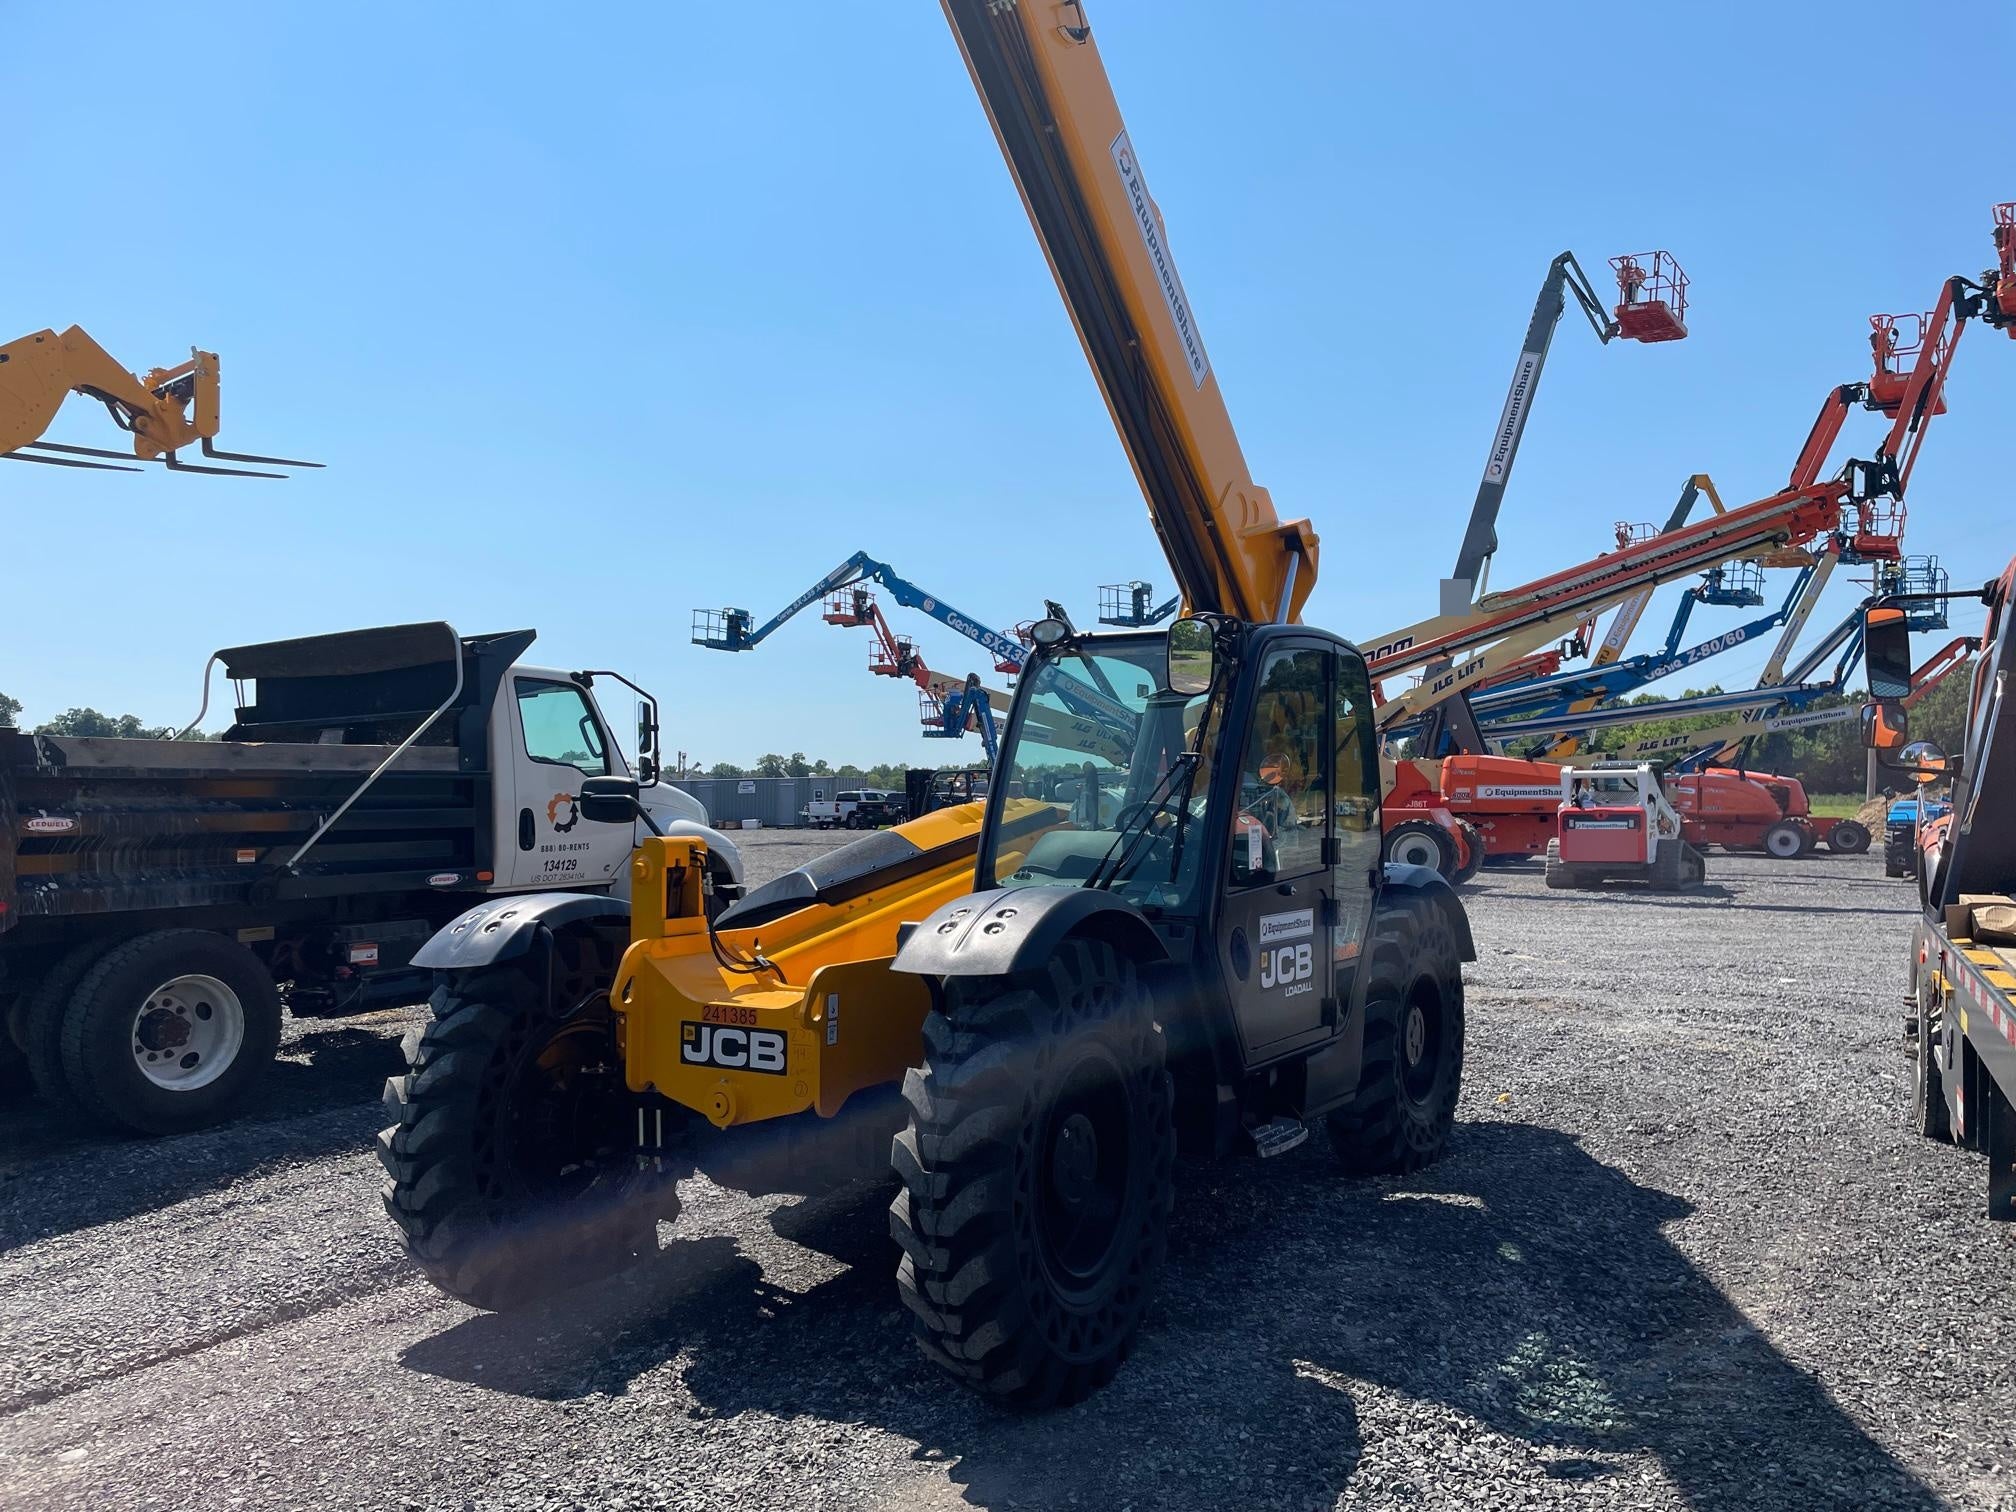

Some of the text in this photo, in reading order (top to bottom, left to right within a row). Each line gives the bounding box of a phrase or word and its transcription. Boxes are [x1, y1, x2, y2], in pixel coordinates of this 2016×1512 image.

[1128, 174, 1203, 373] EquipmentShare
[1494, 360, 1533, 462] EquipmentShare
[946, 611, 980, 640] Genie
[1686, 628, 1745, 664] Z-80/60
[1431, 656, 1485, 695] JLG LIFT
[1070, 721, 1093, 734] JLG
[1781, 709, 1847, 727] EquipmentShare
[1636, 735, 1690, 752] JLG LIFT
[1494, 788, 1563, 797] EquipmentShar
[543, 858, 578, 872] 134129
[542, 873, 558, 882] DOT
[1267, 918, 1312, 935] EquipmentShare
[1261, 943, 1313, 989] JCB
[1285, 981, 1313, 997] LOADALL
[703, 1005, 757, 1025] 241385
[683, 1026, 785, 1071] JCB
